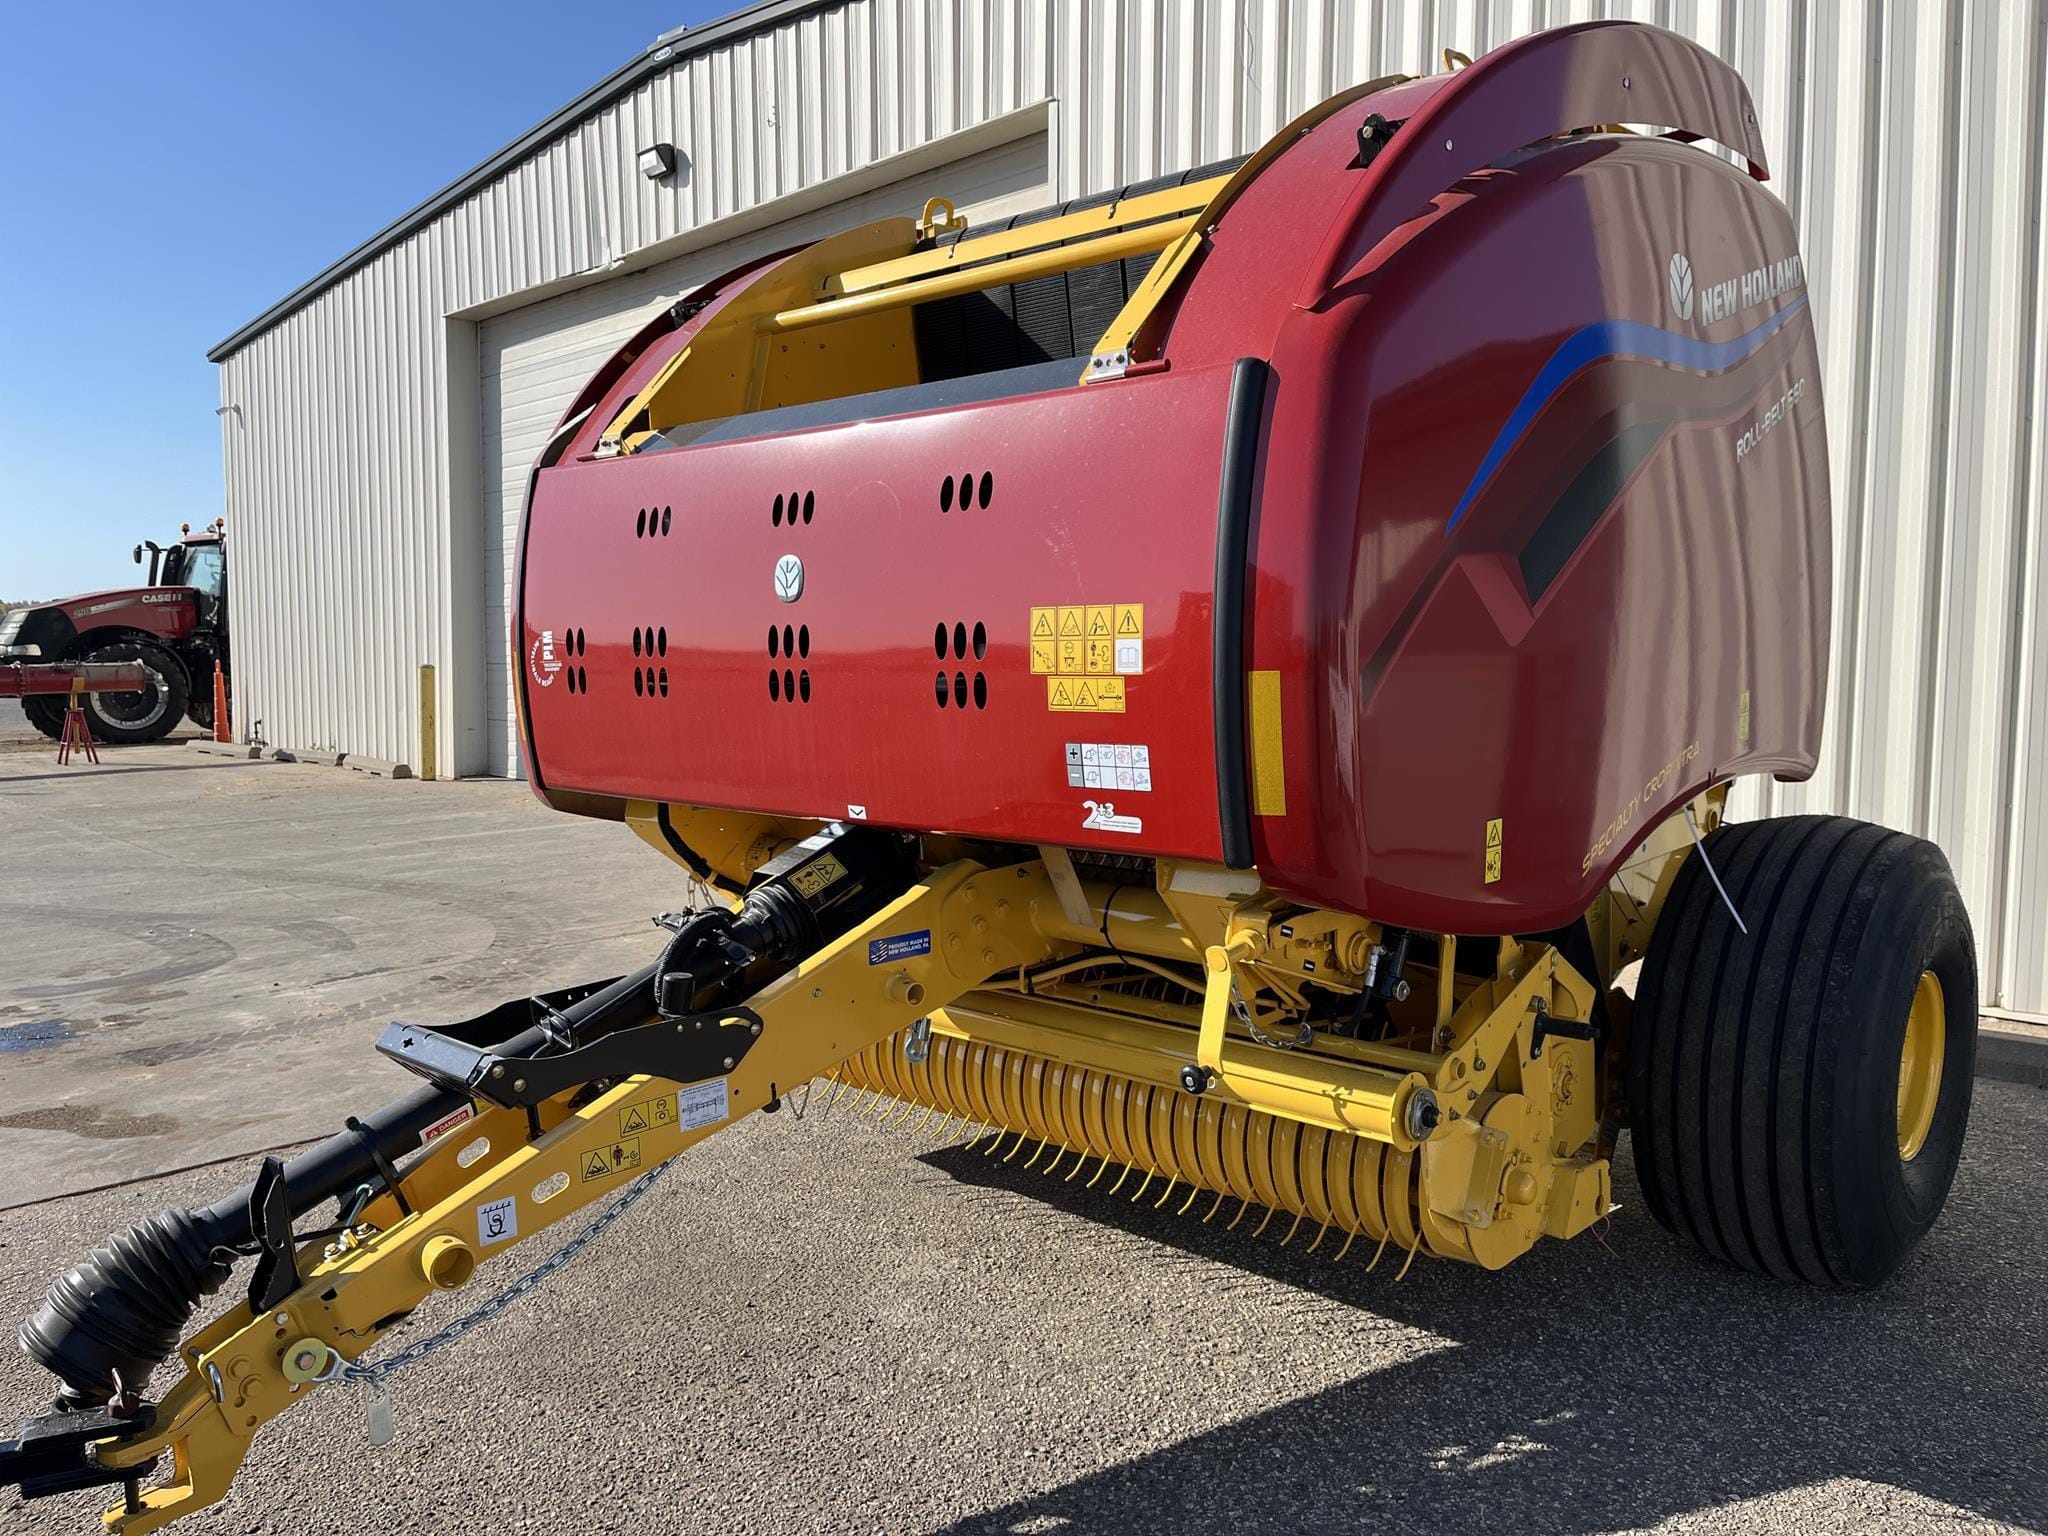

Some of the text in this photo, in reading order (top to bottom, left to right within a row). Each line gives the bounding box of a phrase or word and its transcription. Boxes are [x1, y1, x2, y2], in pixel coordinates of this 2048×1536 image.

[1701, 255, 1802, 327] NEW HOLLAND
[141, 593, 171, 603] CASE
[542, 630, 554, 660] PLM
[1582, 791, 1641, 877] SPECIALTY
[888, 941, 909, 950] PROUDLY
[909, 938, 923, 946] MADE
[439, 1111, 468, 1132] DANGER
